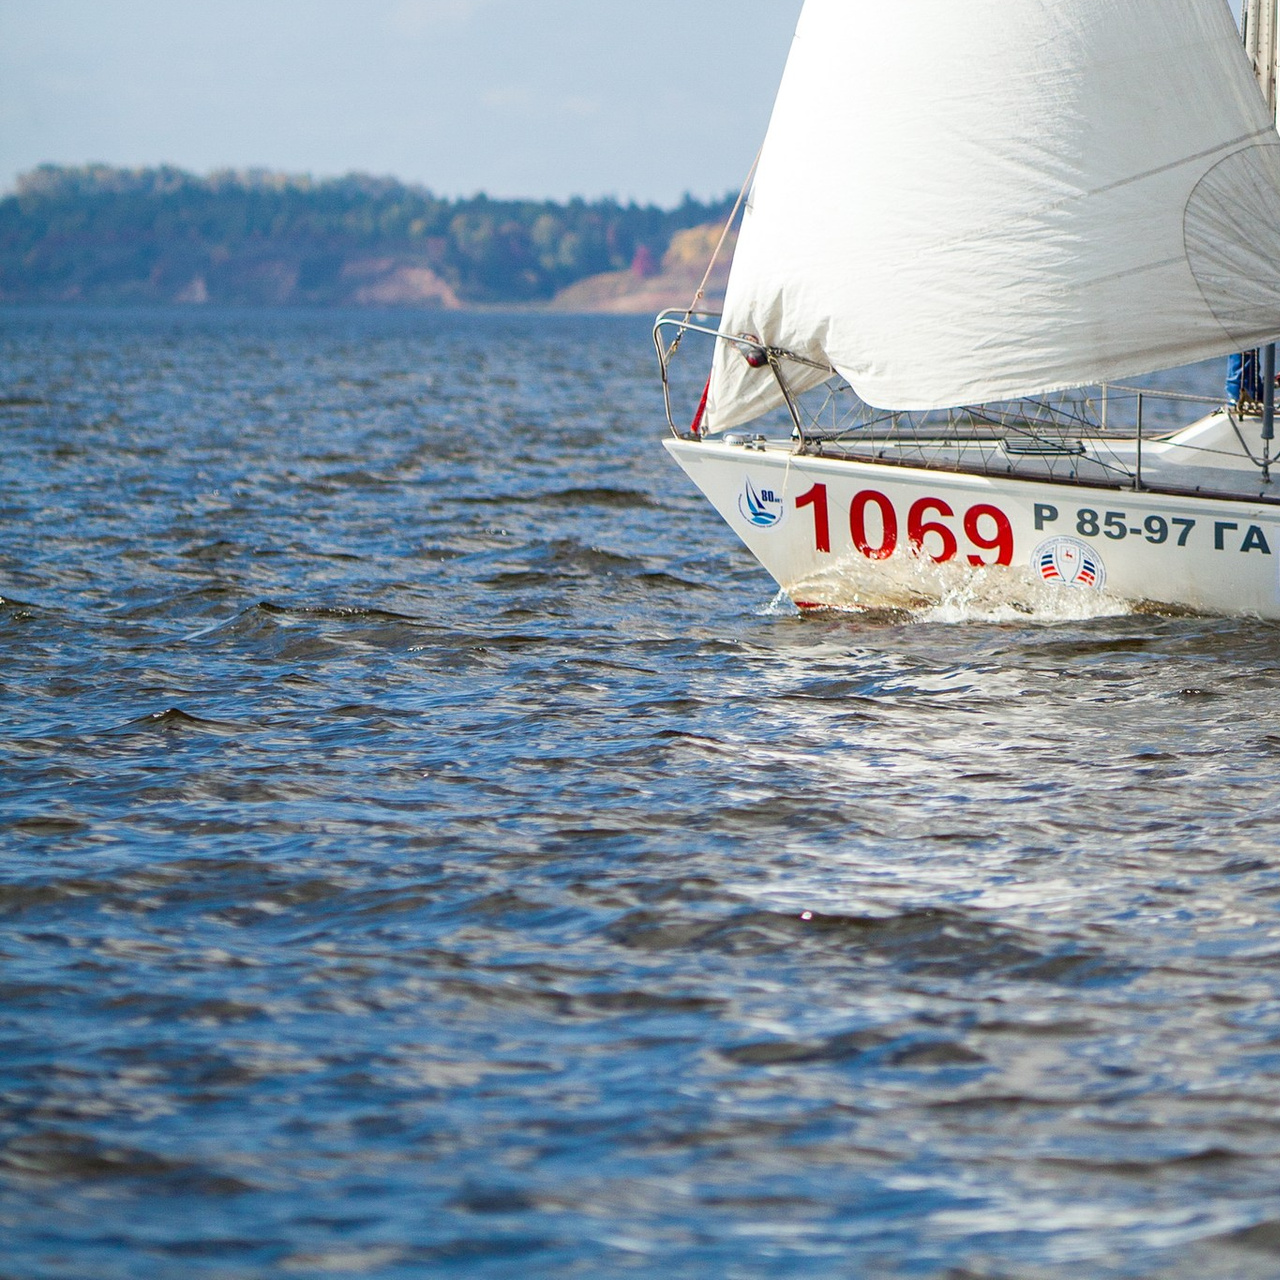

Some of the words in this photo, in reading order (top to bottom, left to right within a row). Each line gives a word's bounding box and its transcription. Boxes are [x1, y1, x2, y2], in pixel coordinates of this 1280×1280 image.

[761, 489, 774, 502] 80
[795, 483, 1014, 568] 1069
[1076, 508, 1197, 547] 85-97
[1214, 521, 1272, 555] ГА
